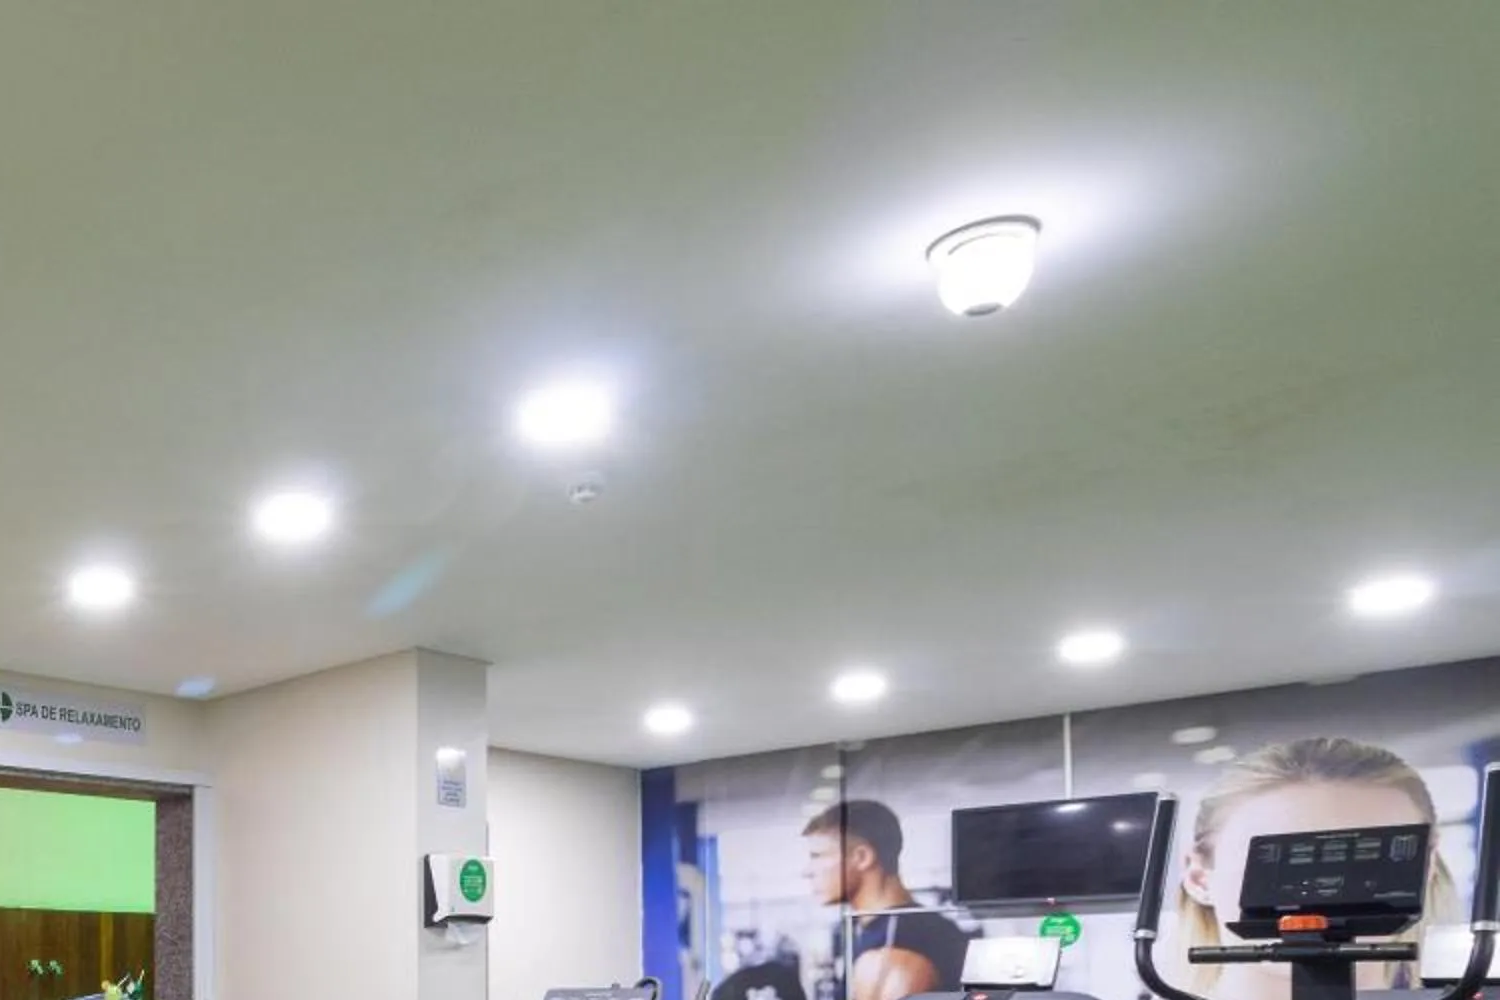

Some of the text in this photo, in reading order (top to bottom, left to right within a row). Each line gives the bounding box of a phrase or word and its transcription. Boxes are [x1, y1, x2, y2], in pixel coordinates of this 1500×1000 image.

[16, 702, 142, 732] SPA DE RELAXAMENTO
